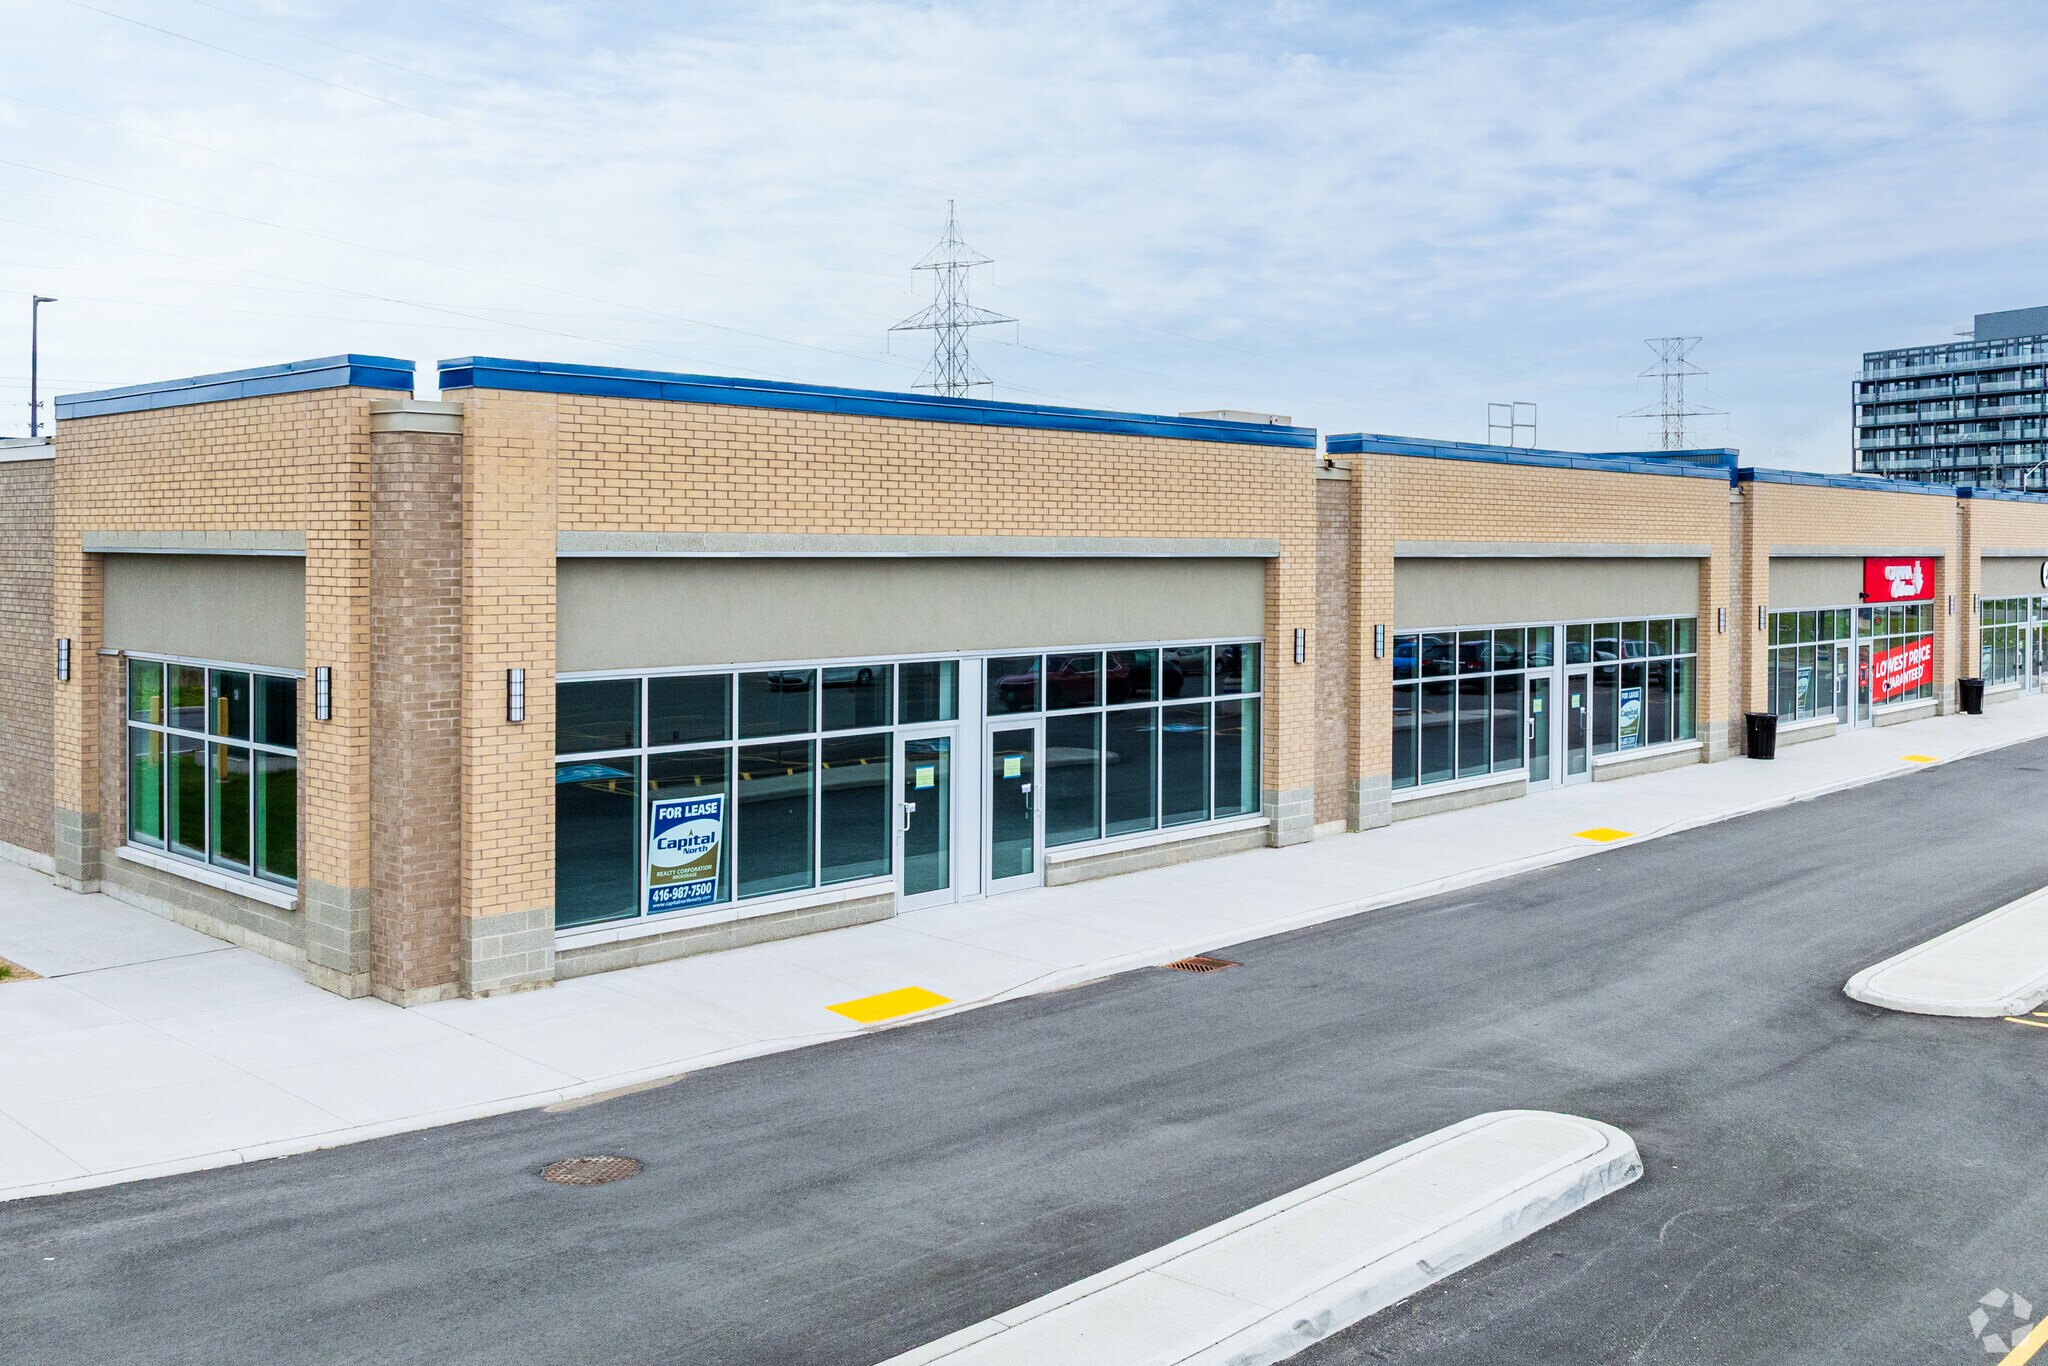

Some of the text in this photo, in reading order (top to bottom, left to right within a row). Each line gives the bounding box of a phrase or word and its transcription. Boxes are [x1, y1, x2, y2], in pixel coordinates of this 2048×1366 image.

[1875, 644, 1931, 678] LOWEST PRICE
[659, 802, 718, 820] FOR LEASE
[657, 831, 715, 850] Capital
[683, 845, 708, 854] North
[656, 864, 712, 877] REALTY CORPORATION
[672, 872, 697, 880] BROKERAGE
